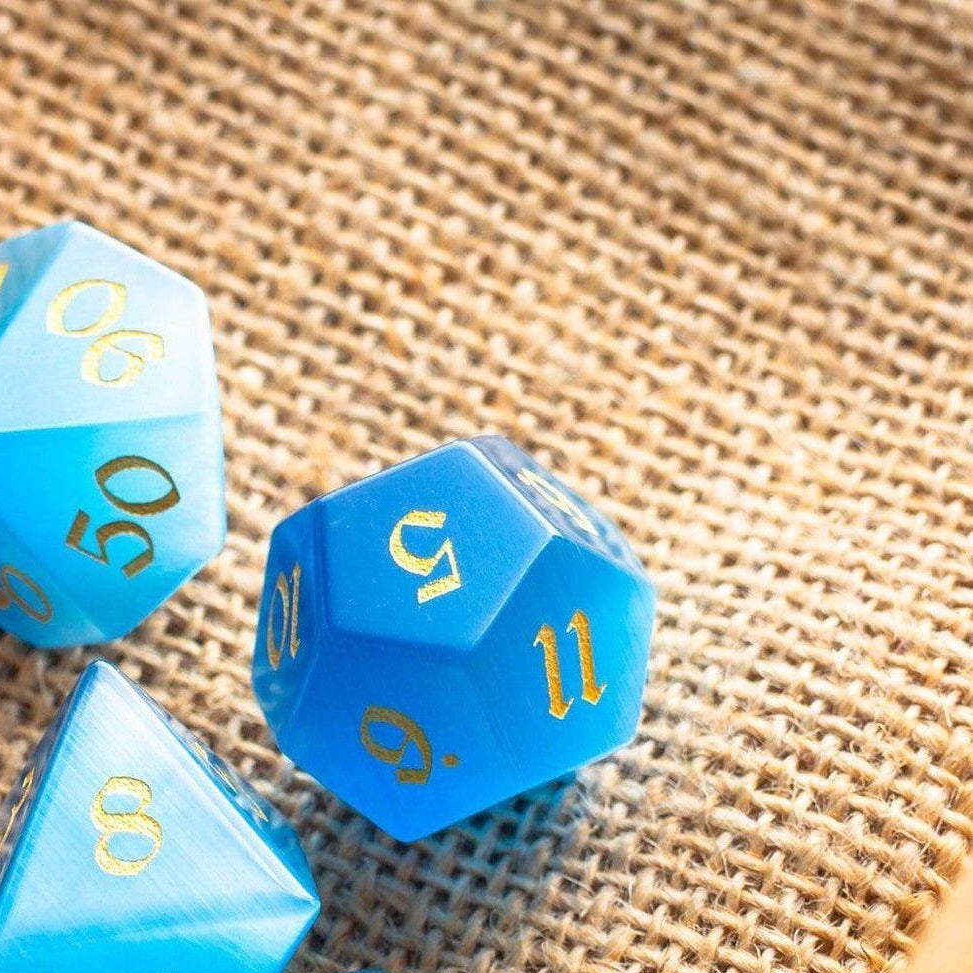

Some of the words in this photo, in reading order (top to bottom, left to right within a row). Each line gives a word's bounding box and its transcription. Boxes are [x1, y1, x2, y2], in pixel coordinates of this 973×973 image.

[65, 455, 181, 579] 50
[388, 509, 462, 604] 5
[266, 561, 302, 671] 10
[532, 609, 607, 720] 11
[91, 776, 163, 876] 8
